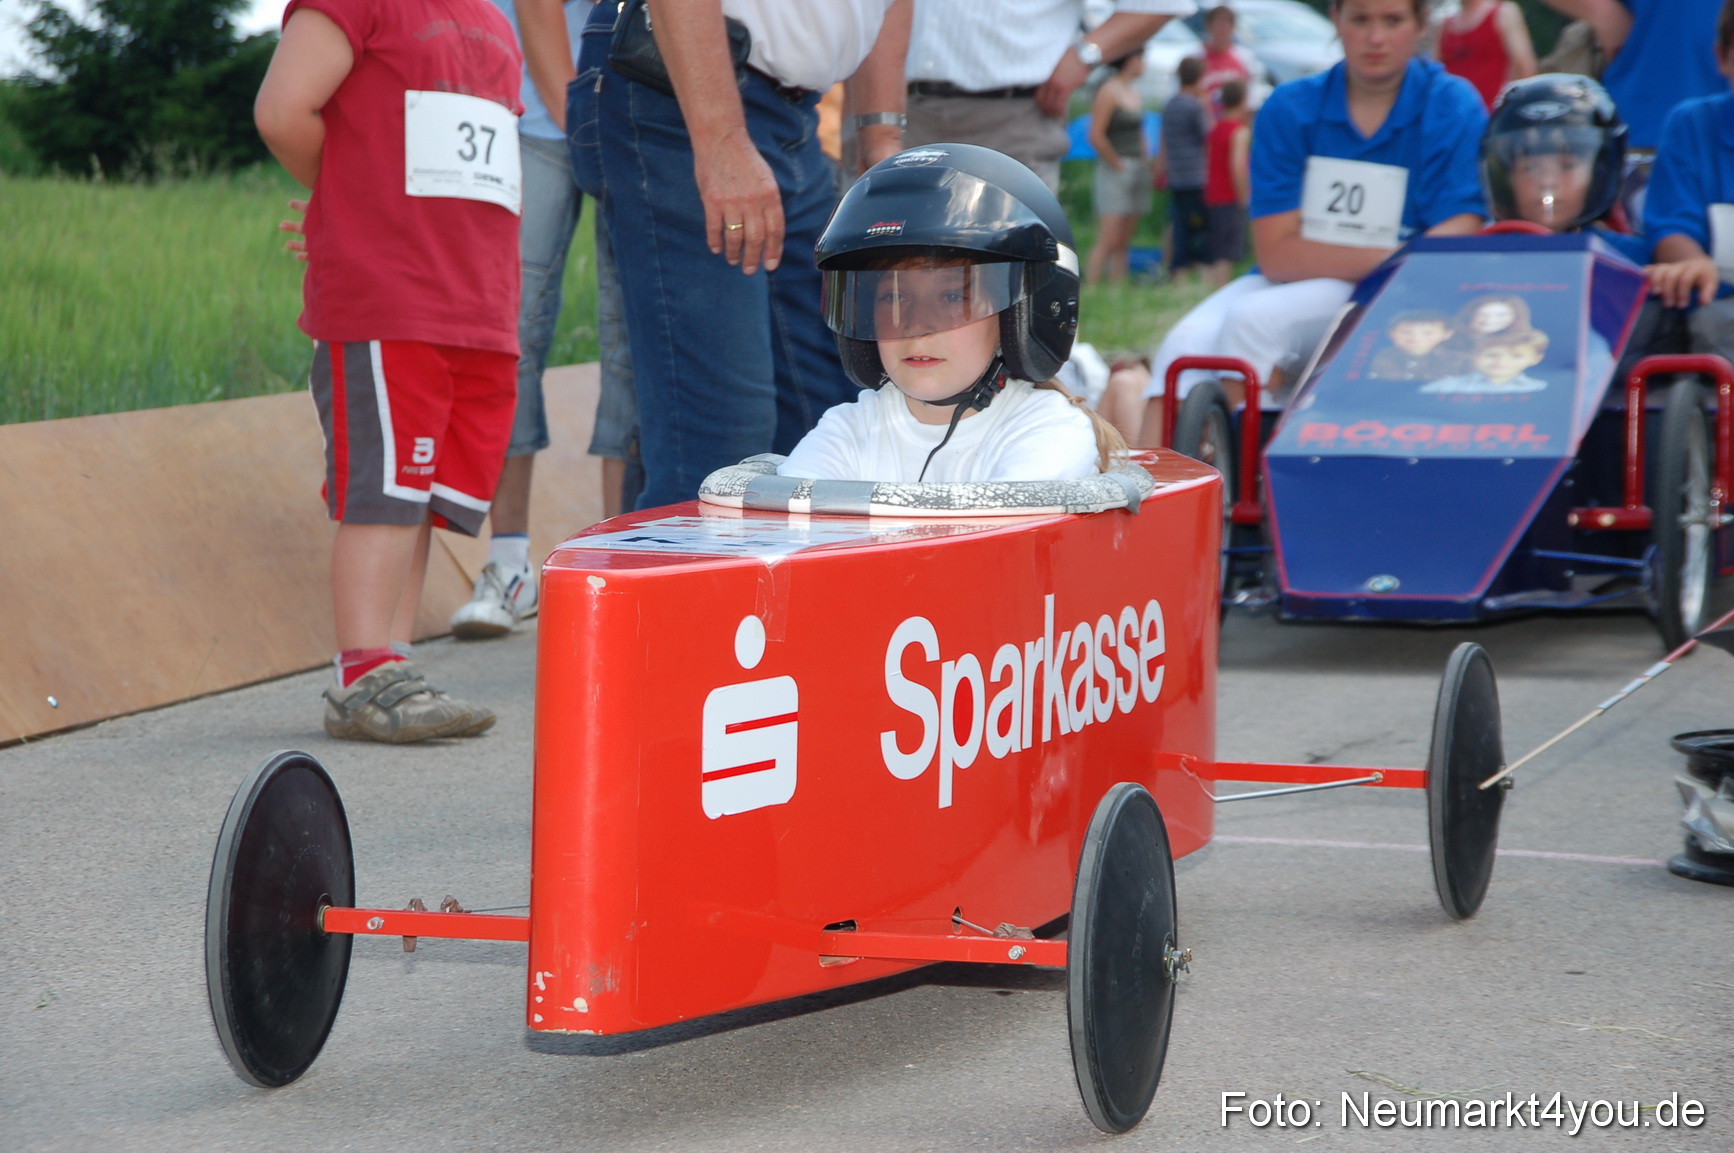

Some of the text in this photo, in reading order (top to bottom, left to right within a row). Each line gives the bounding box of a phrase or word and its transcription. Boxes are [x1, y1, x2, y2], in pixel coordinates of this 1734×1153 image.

[457, 120, 497, 165] 37
[1327, 180, 1365, 215] 20
[1298, 420, 1551, 443] BÖGERL
[880, 594, 1166, 809] Sparkasse
